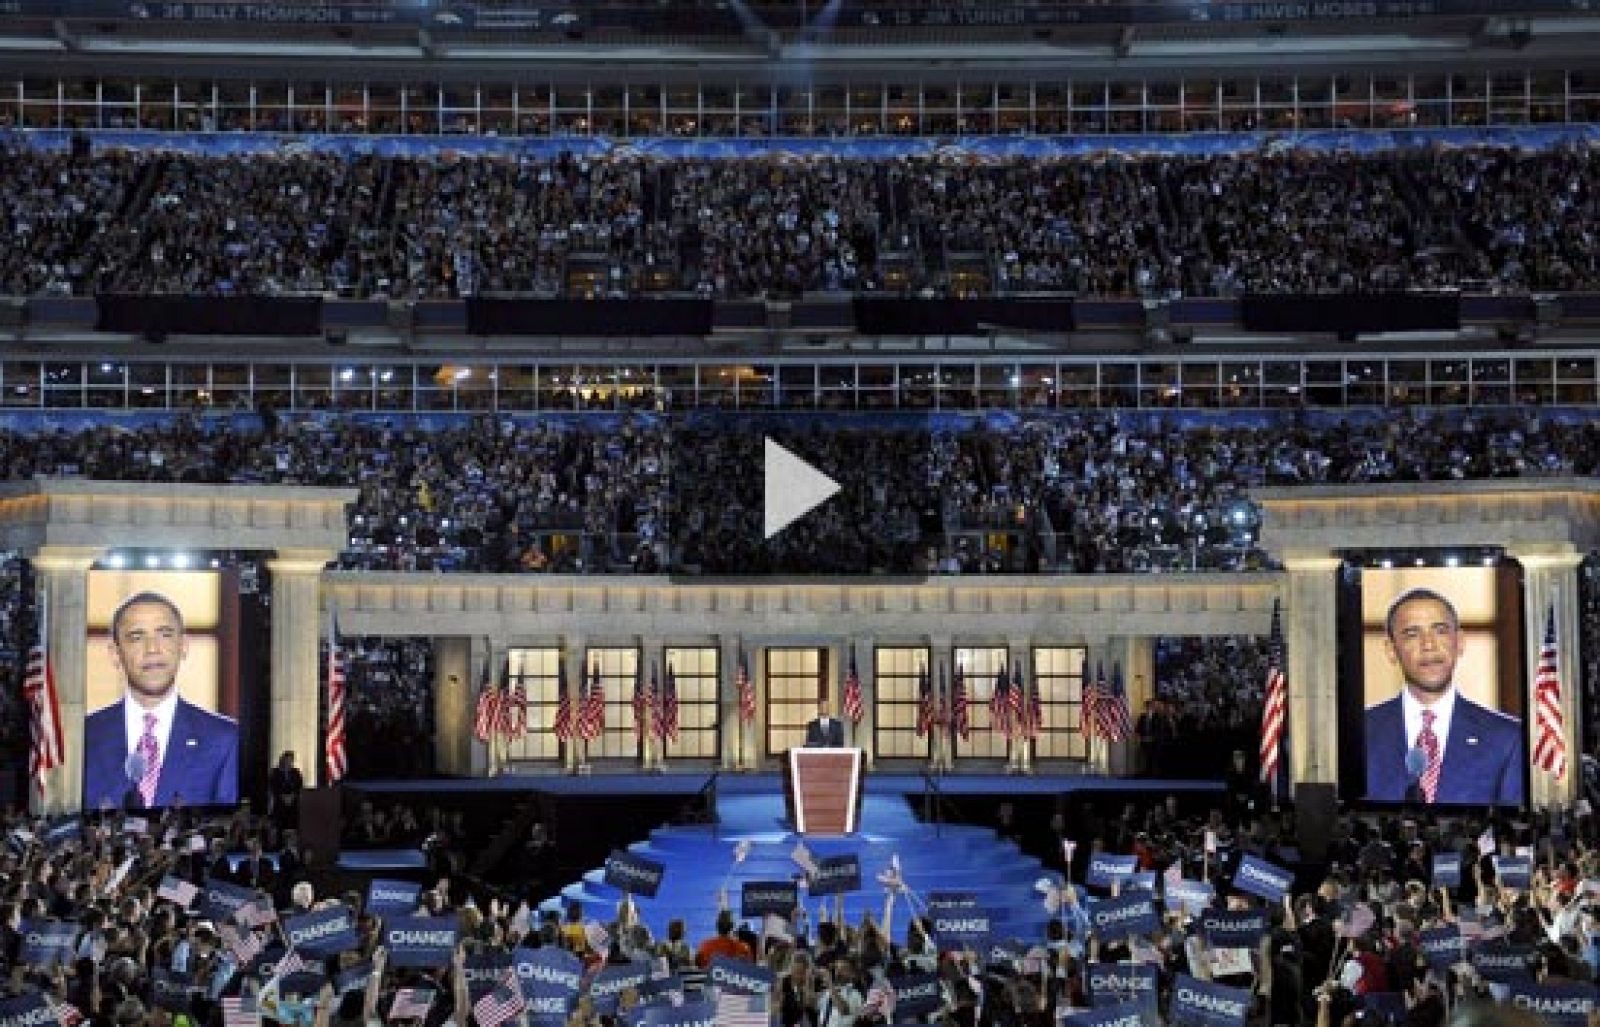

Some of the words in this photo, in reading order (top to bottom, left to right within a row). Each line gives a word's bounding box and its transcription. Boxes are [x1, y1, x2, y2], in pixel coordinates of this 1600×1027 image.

[245, 5, 341, 22] THOMPSON
[957, 8, 1025, 24] TURNER
[1251, 3, 1308, 18] HAVEN
[1315, 2, 1377, 17] MOSES
[1241, 863, 1292, 889] CHANGE
[371, 889, 418, 903] CHANGE
[1096, 900, 1153, 926] CHANGE
[290, 915, 351, 945] CHANGE
[935, 918, 990, 932] CHANGE
[1203, 917, 1263, 933] CHANGE
[389, 930, 455, 947] CHANGE
[517, 962, 580, 990] CHANGE
[590, 974, 648, 996] CHANGE
[712, 967, 771, 994] CHANGE
[1090, 974, 1153, 991] CHANGE
[1177, 988, 1245, 1017] CHANGE
[1511, 994, 1593, 1015] CHANGE
